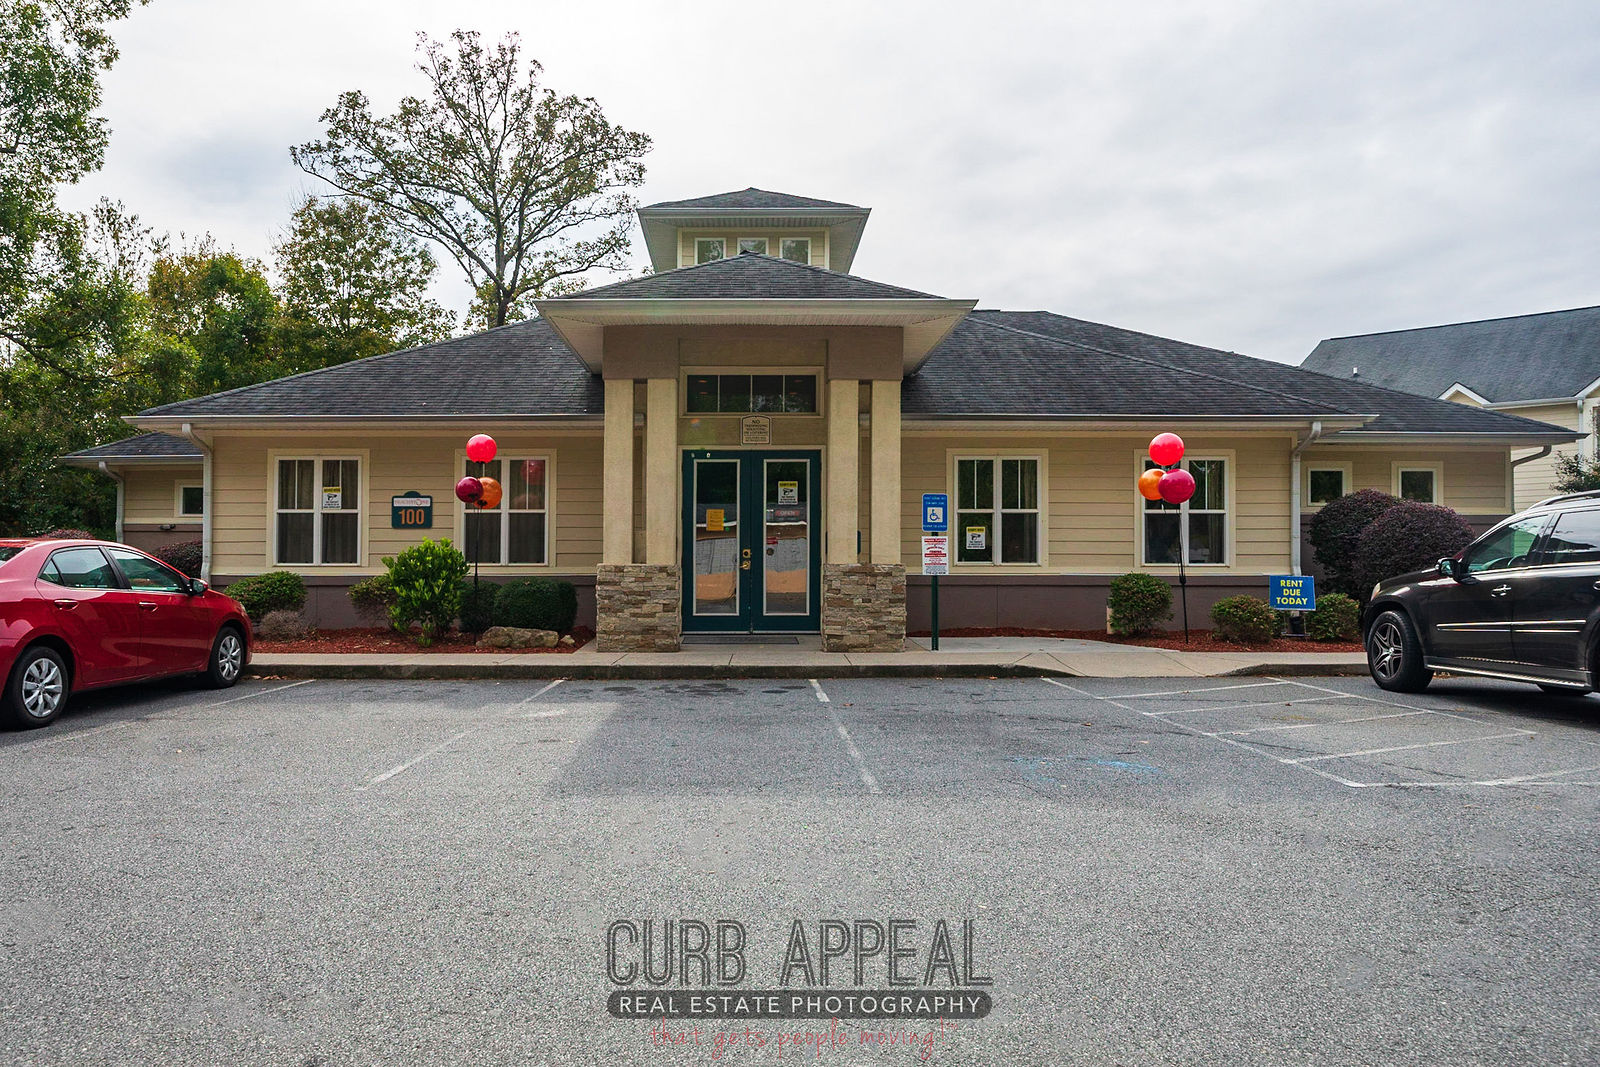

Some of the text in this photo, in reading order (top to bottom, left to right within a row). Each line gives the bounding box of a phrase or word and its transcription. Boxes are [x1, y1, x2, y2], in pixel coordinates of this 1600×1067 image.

[398, 509, 425, 525] 100
[1280, 580, 1303, 588] RENT
[1283, 588, 1301, 596] DUE
[1276, 596, 1308, 605] TODAY
